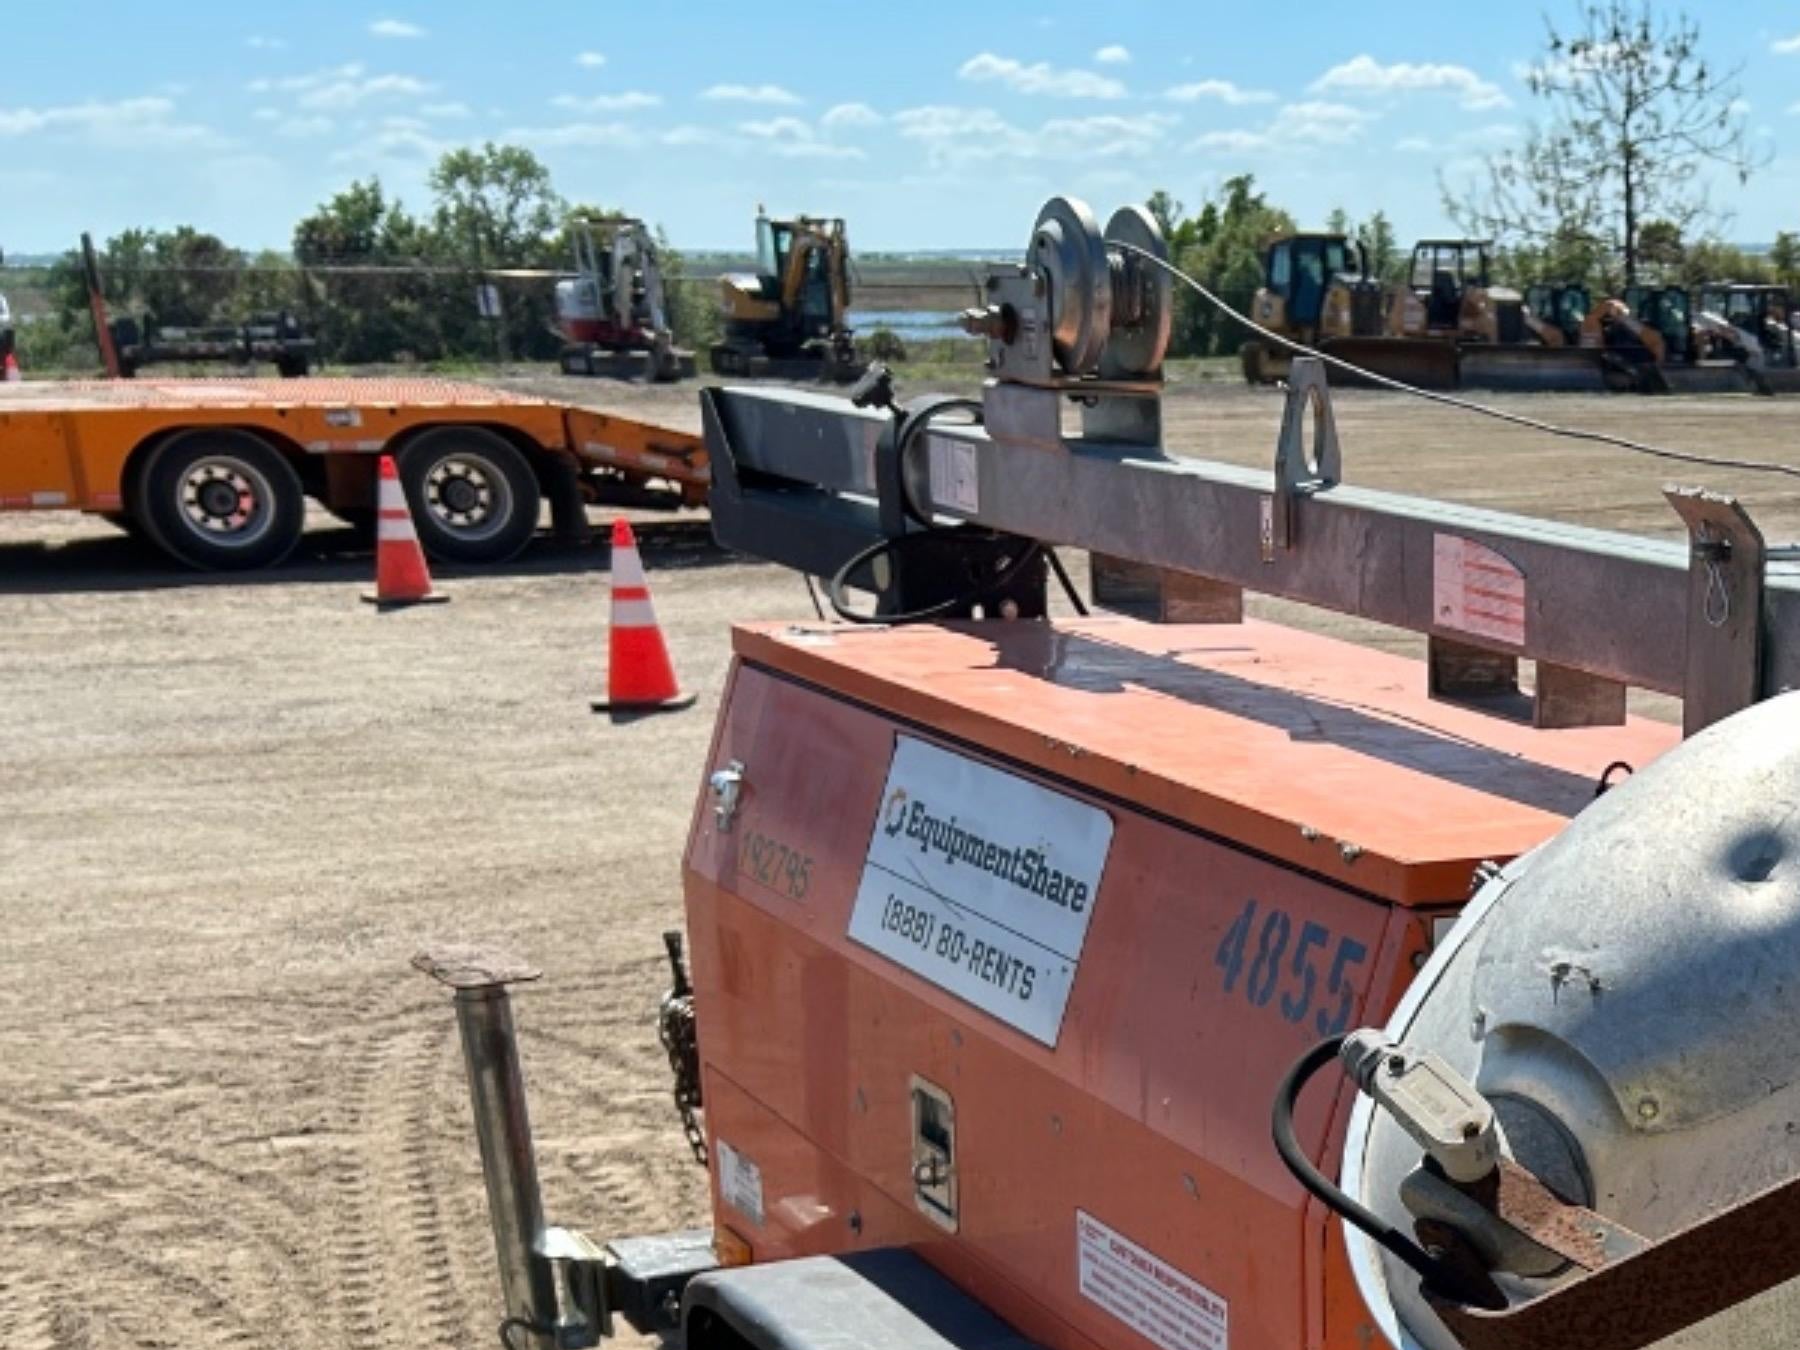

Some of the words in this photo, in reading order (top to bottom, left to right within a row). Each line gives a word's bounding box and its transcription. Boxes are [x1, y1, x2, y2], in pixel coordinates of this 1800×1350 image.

[906, 800, 1088, 912] EquipmentShare
[881, 893, 936, 950] (888)
[936, 923, 1035, 1001] 80-RENTS
[1215, 899, 1367, 1036] 4855
